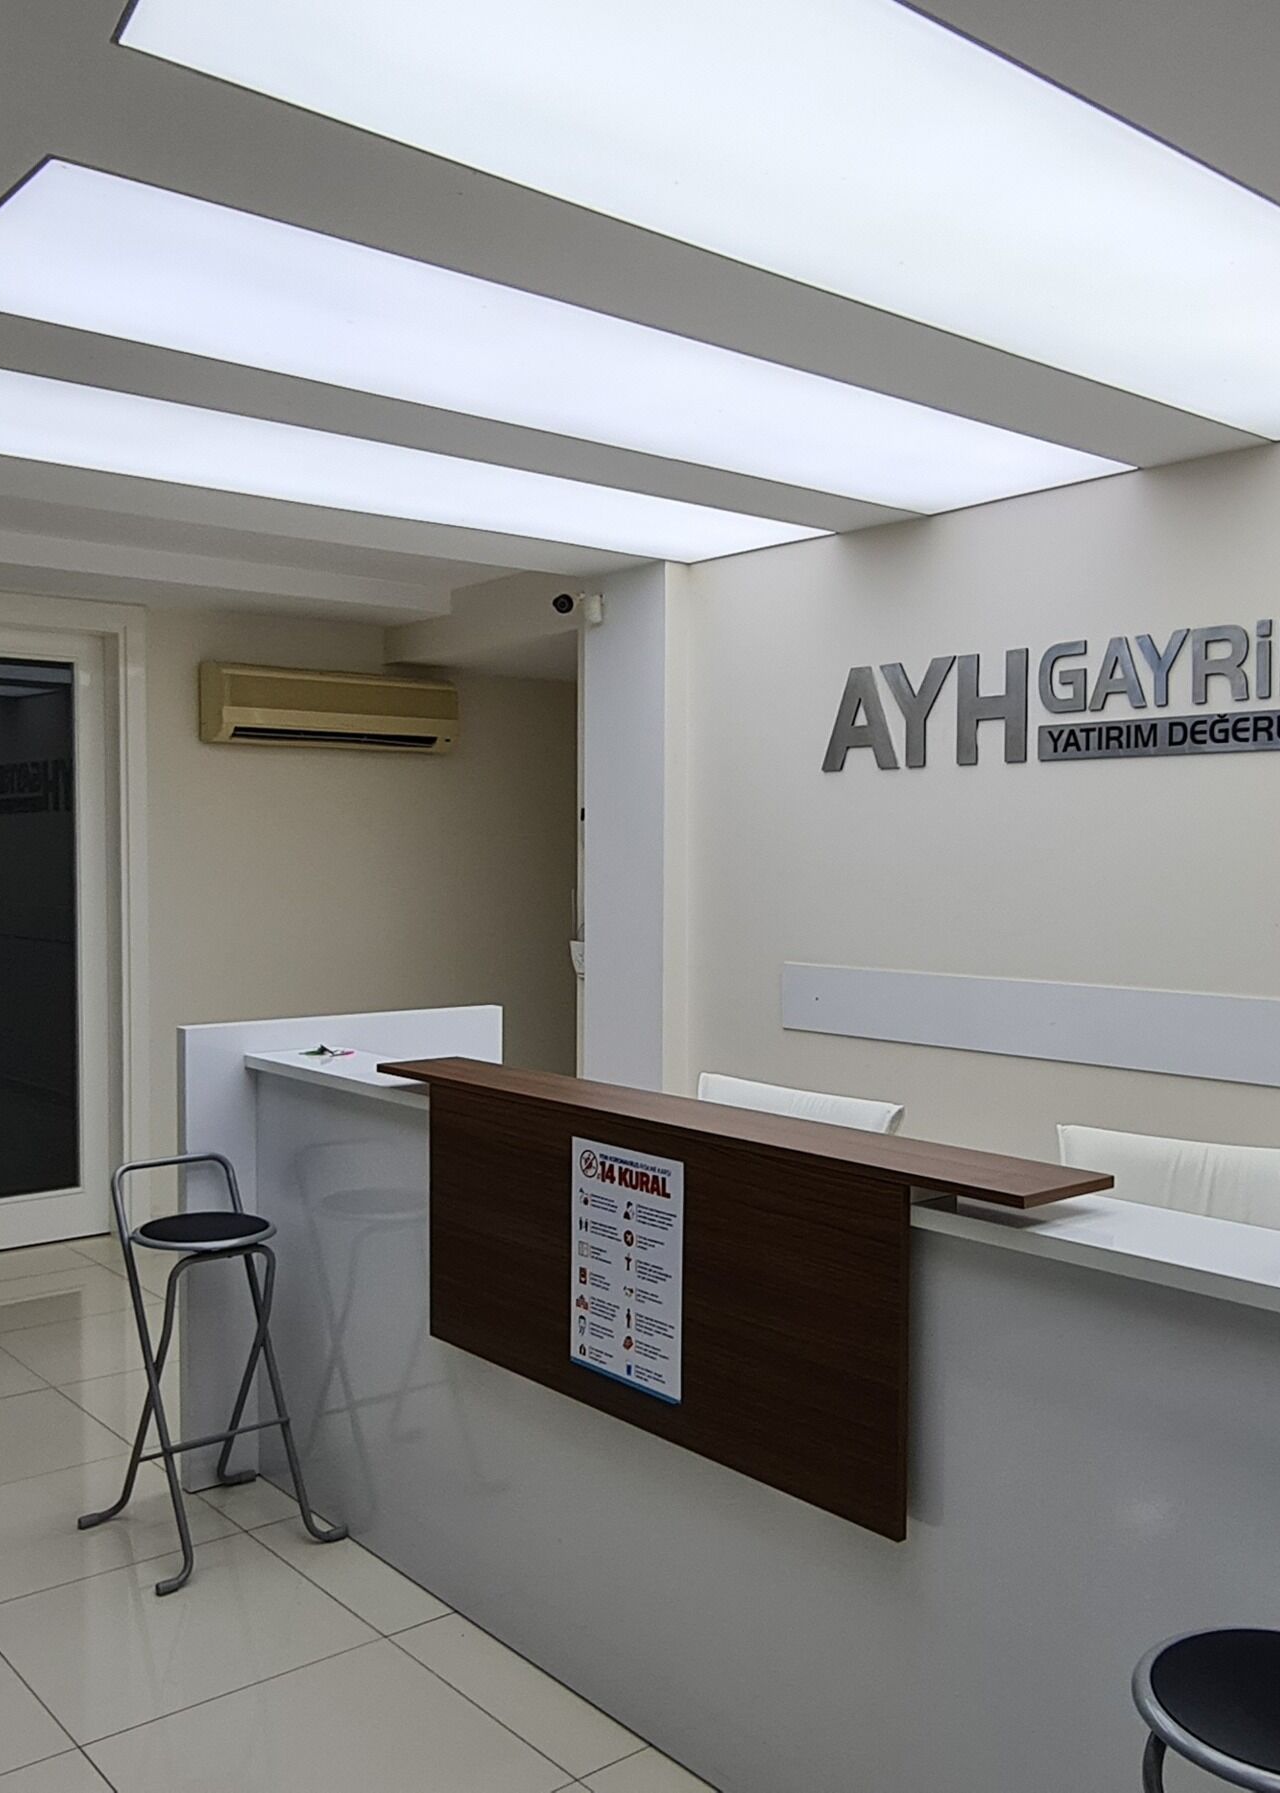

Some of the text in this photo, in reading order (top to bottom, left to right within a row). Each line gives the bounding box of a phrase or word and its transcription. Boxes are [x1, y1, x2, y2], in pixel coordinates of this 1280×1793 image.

[821, 648, 1028, 772] AYH
[1047, 722, 1158, 753] YATIRIM
[599, 1161, 616, 1185] 14
[618, 1166, 671, 1199] KURAL
